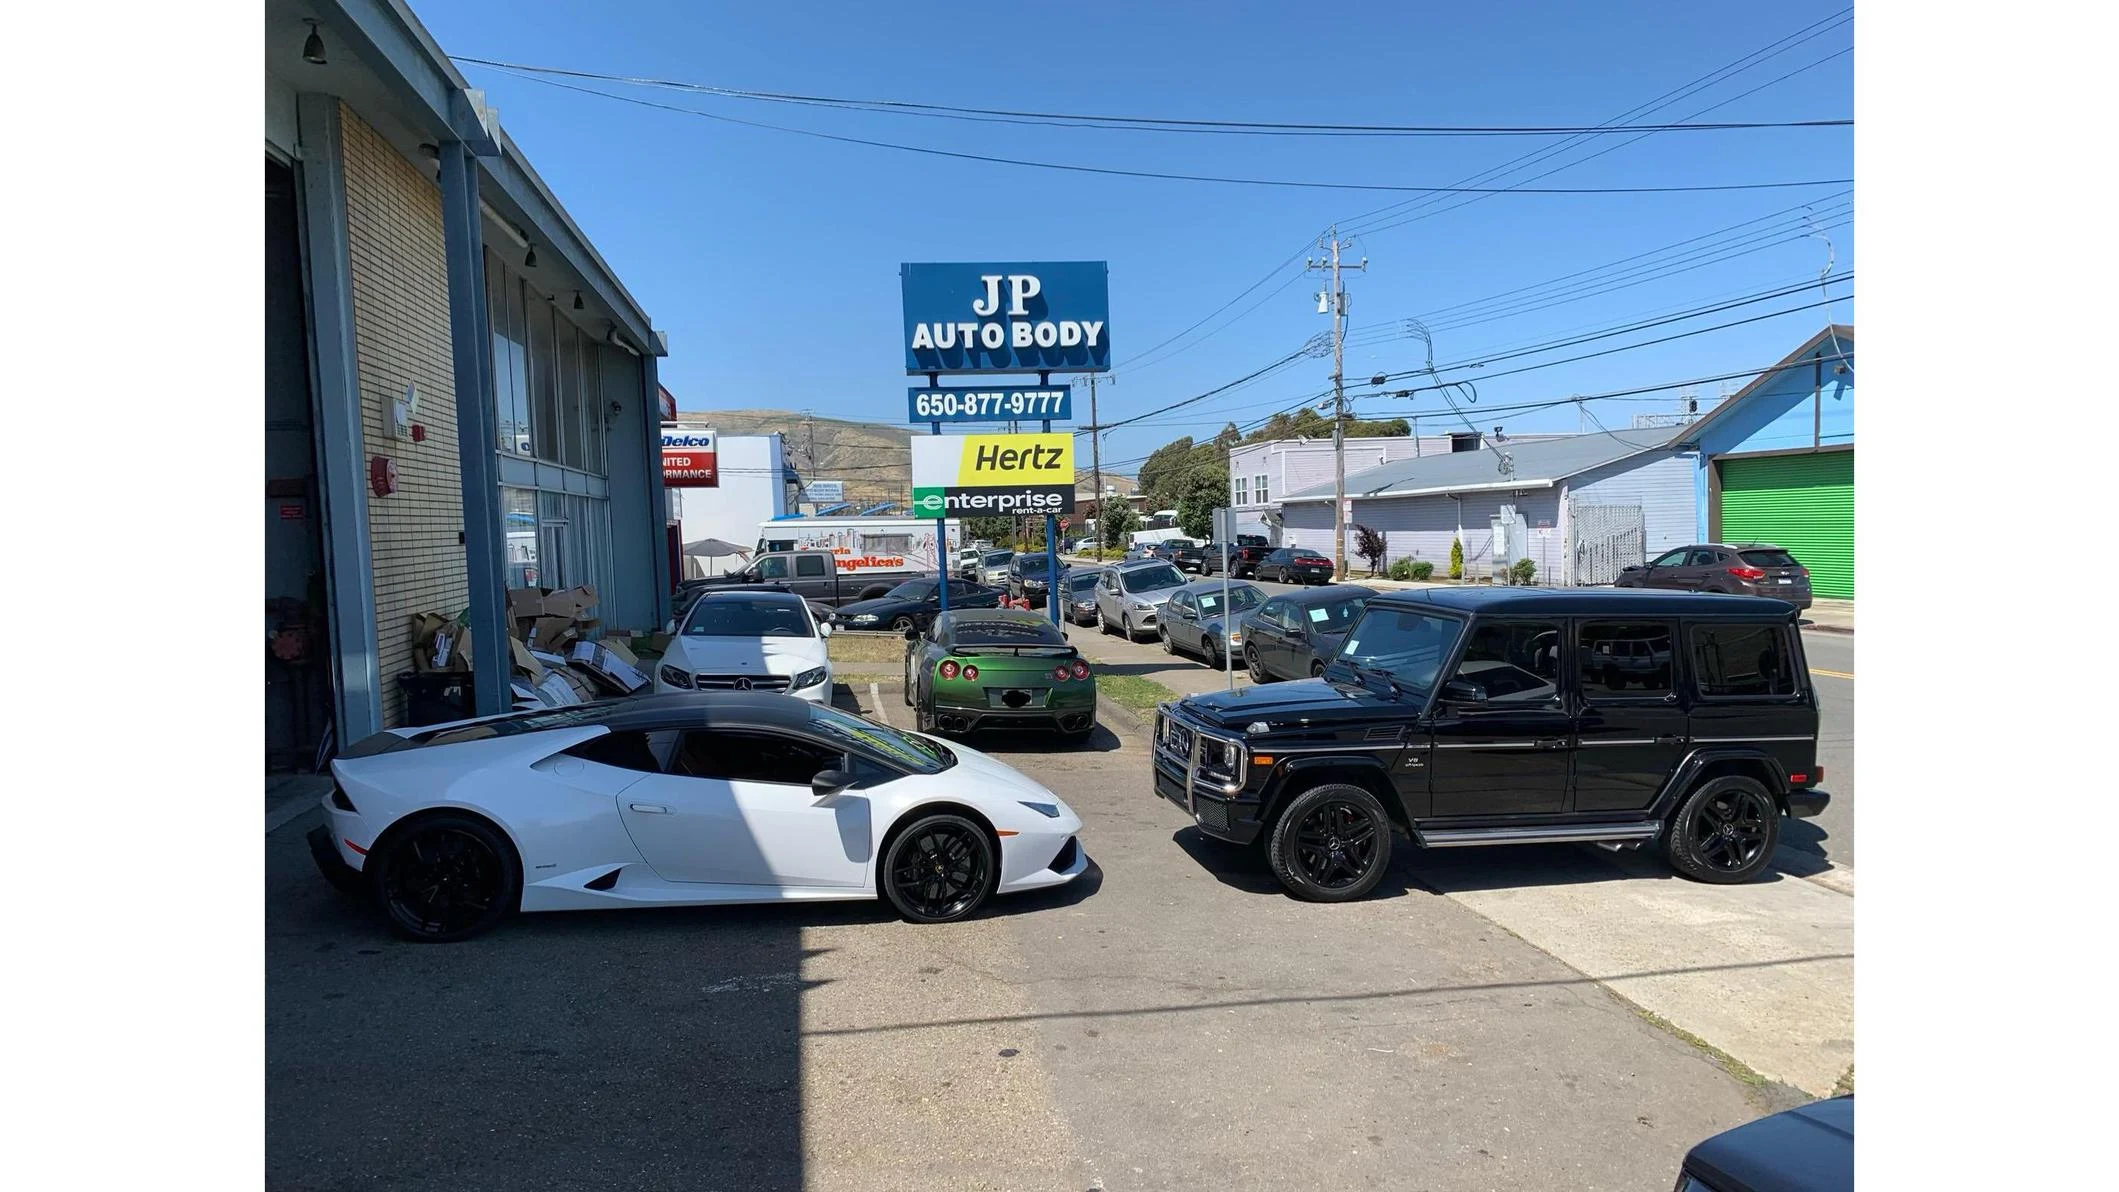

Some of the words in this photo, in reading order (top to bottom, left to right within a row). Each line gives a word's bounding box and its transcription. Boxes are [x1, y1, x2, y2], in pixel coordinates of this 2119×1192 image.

[973, 275, 1041, 316] JP
[912, 323, 1004, 349] AUTO
[1012, 321, 1104, 347] BODY
[916, 391, 1064, 416] 650-877-9777
[975, 444, 1064, 471] Hertz
[922, 490, 1063, 512] enterprise
[1012, 507, 1063, 515] rent-a-car
[834, 555, 903, 571] ngelica's
